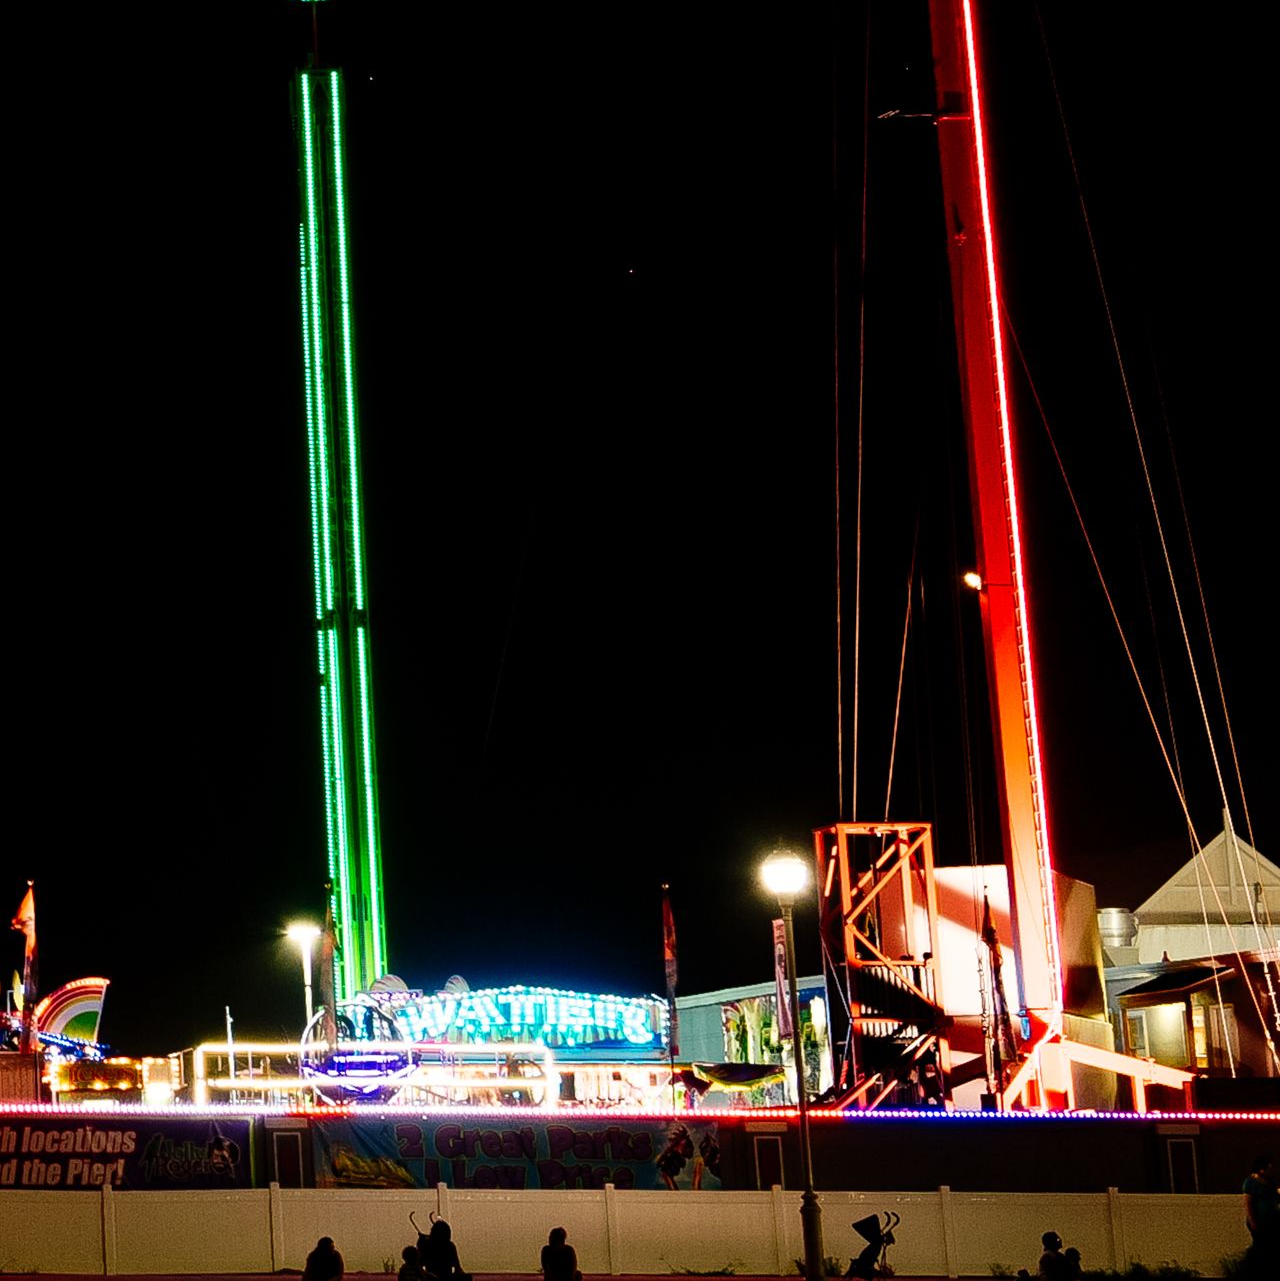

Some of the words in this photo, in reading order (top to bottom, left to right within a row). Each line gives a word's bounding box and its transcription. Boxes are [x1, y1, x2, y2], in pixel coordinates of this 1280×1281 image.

[20, 1125, 137, 1153] locations
[394, 1124, 424, 1159] 2
[435, 1123, 537, 1160] Great
[546, 1124, 653, 1161] Parks
[23, 1159, 62, 1185] the
[65, 1158, 125, 1186] Pier!
[453, 1161, 526, 1188] Low
[539, 1161, 634, 1188] Price
